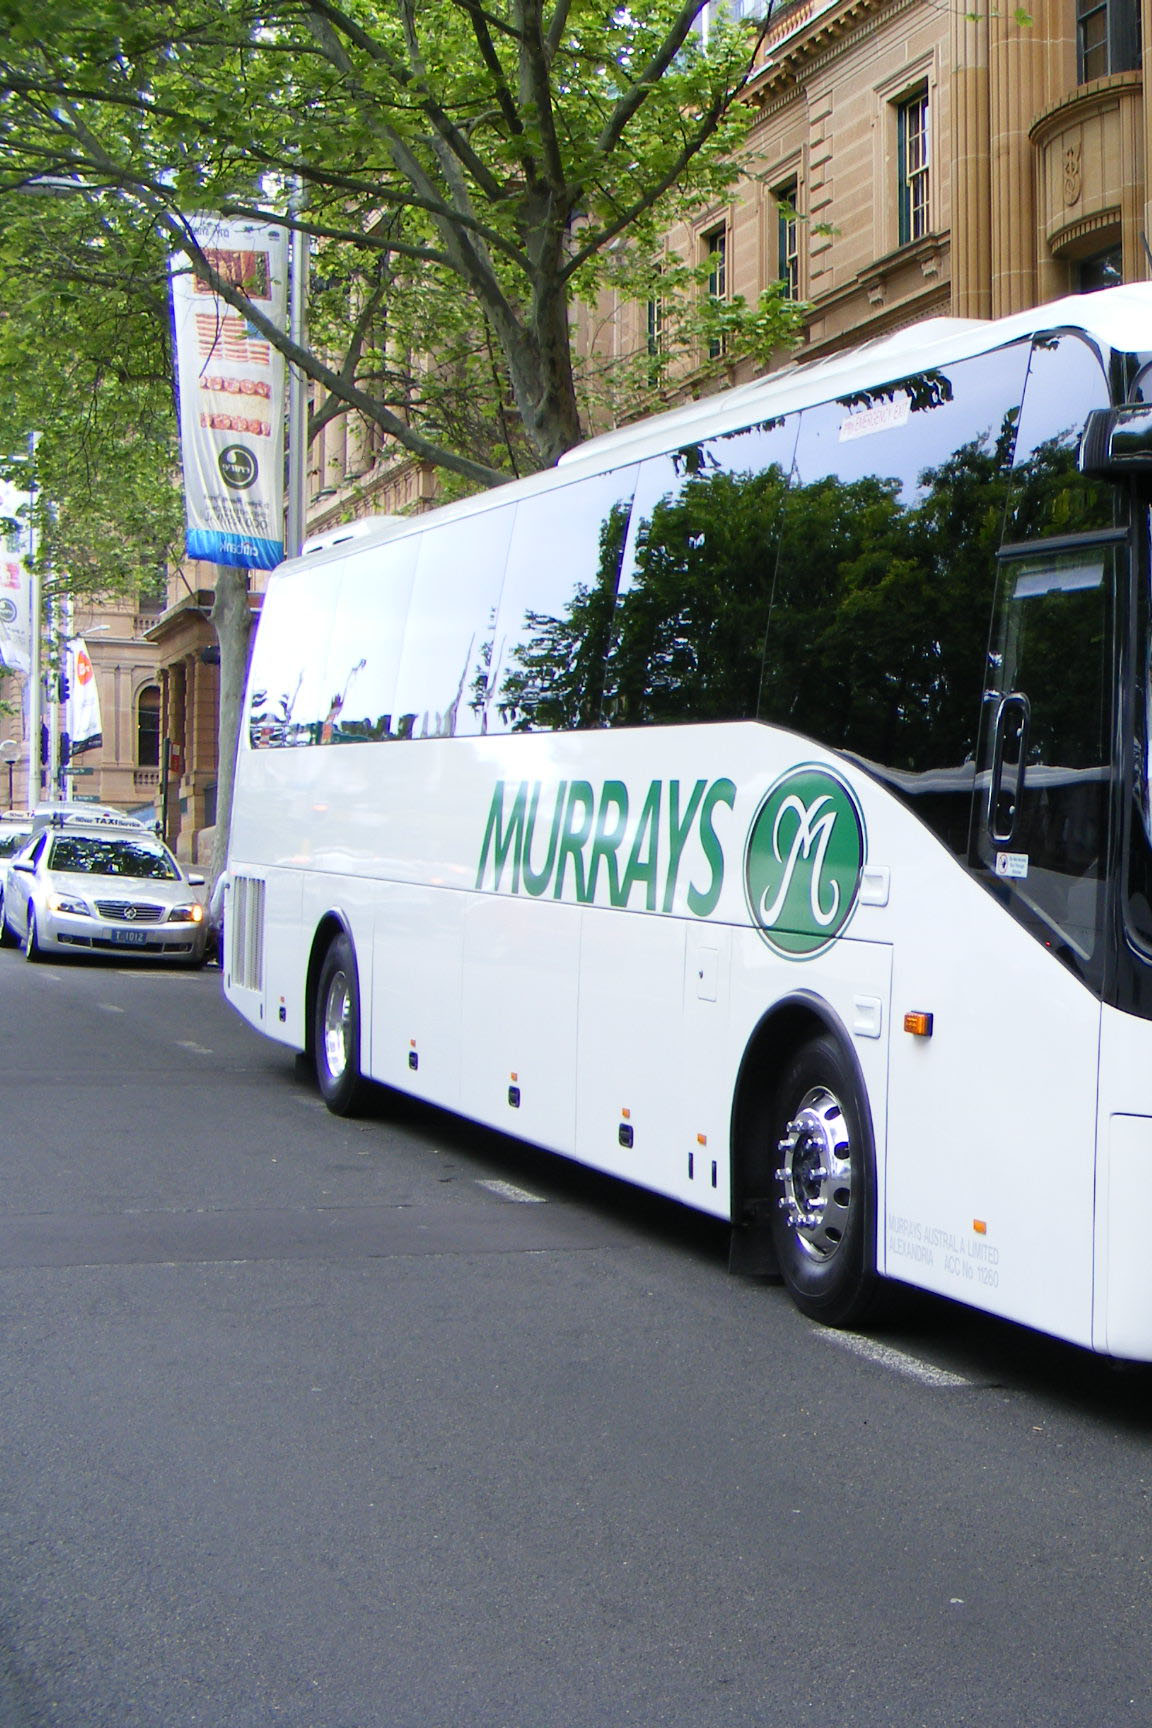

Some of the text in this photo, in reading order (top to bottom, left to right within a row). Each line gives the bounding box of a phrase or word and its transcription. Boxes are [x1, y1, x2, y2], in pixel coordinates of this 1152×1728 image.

[94, 817, 118, 825] TAXI
[475, 777, 737, 917] MURRAYS
[888, 1213, 1000, 1266] MURRAYS AUSTRALA LIMITED
[888, 1235, 934, 1267] ALEXANDRIA
[943, 1254, 961, 1277] ACC
